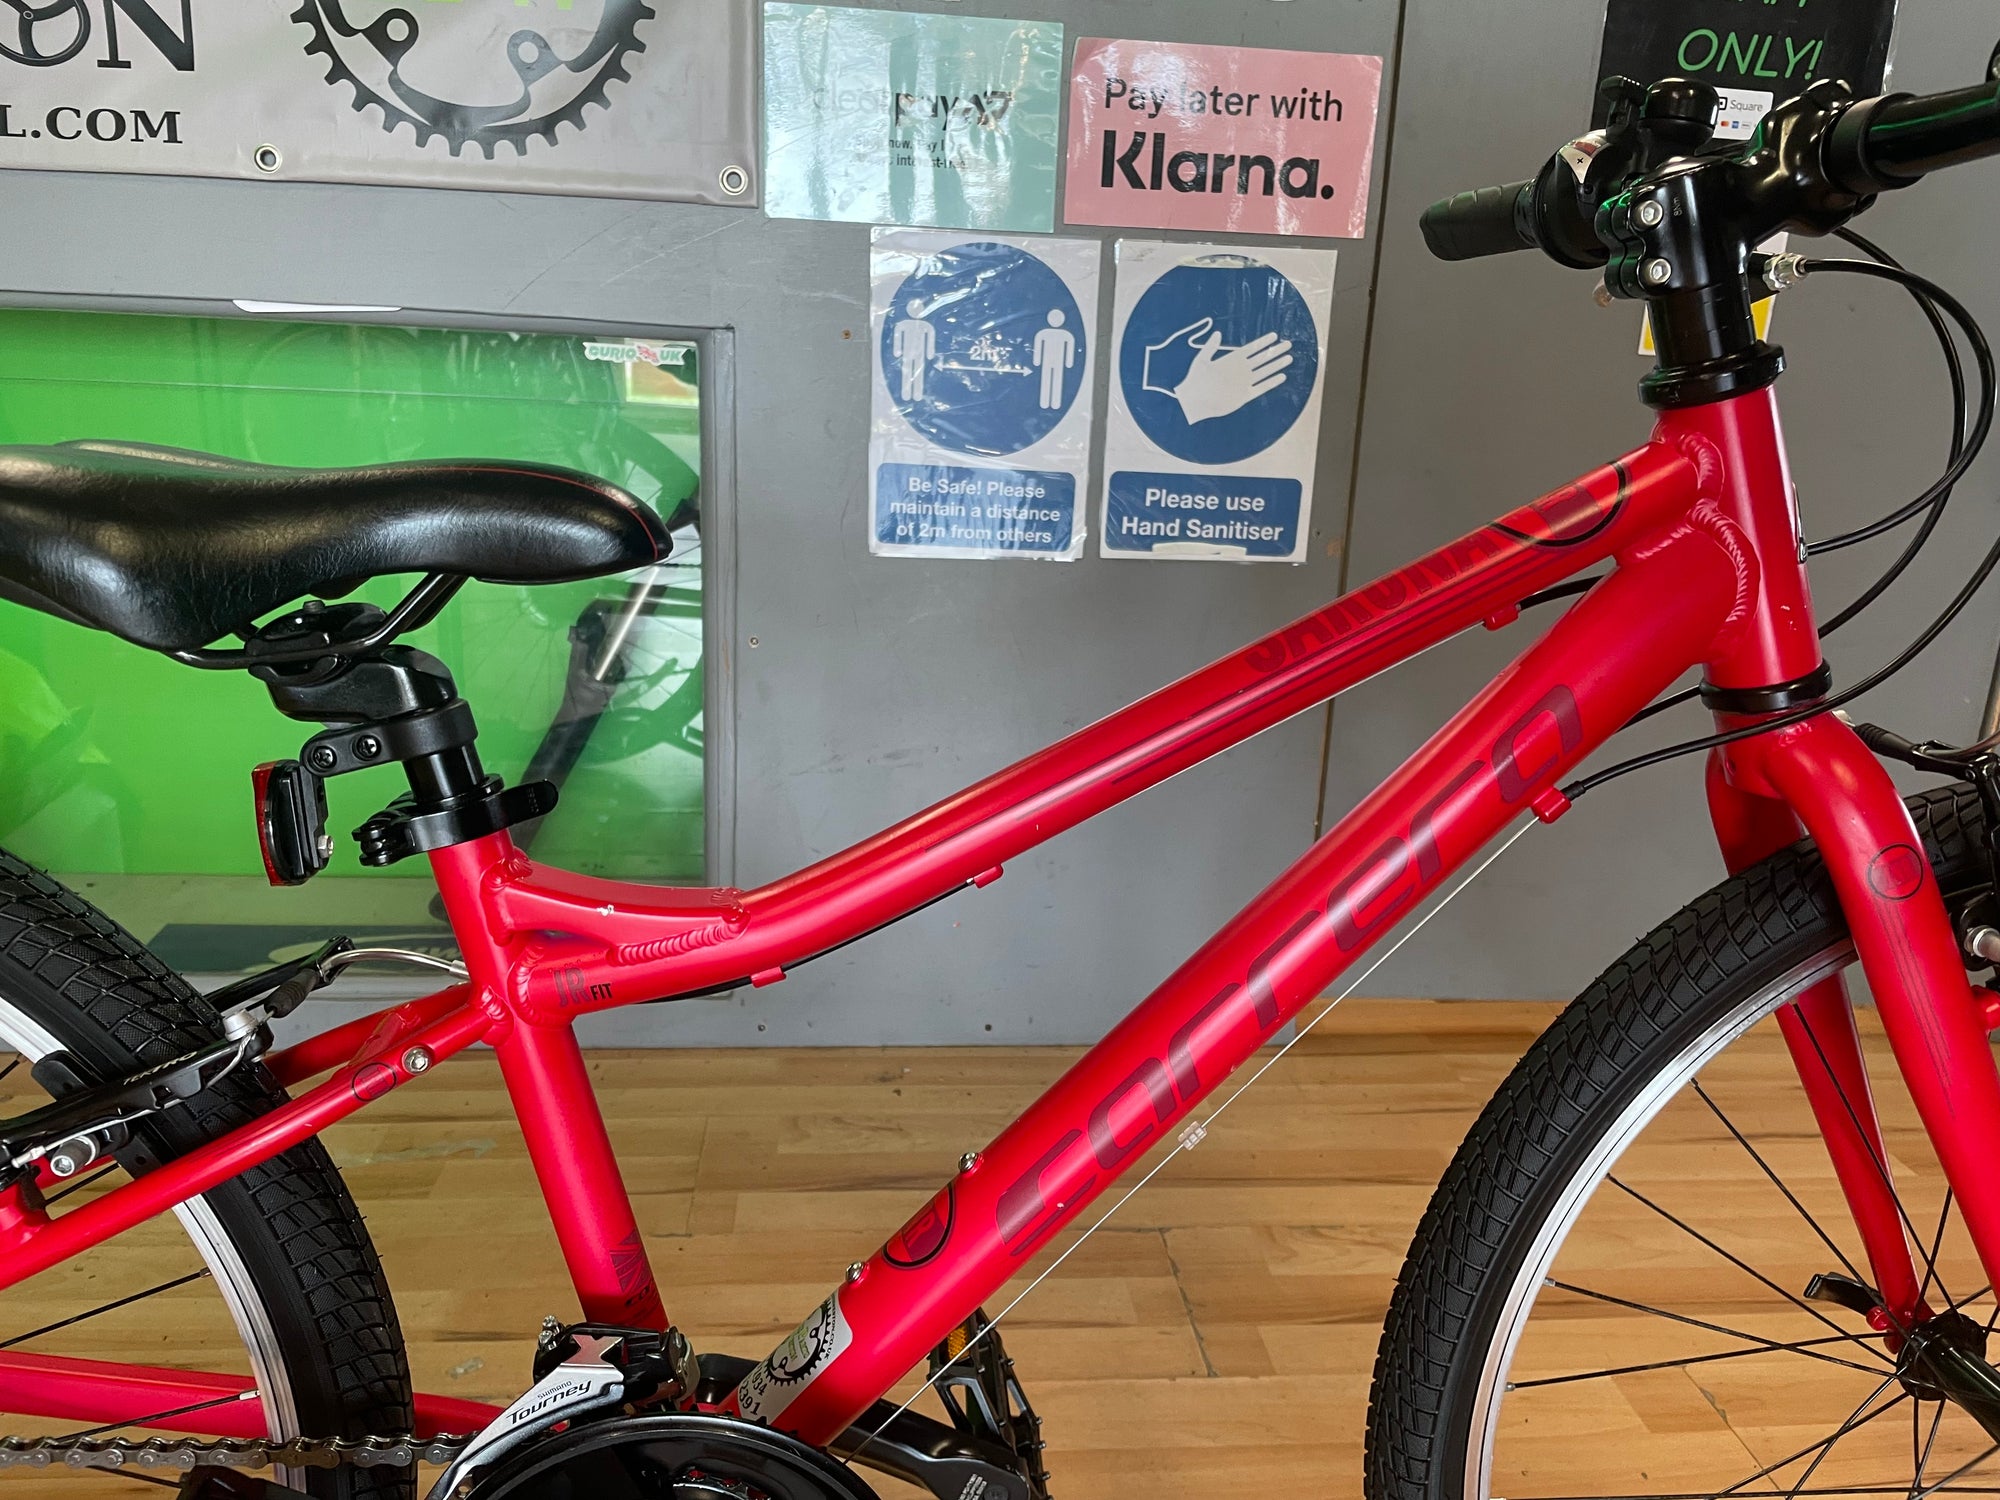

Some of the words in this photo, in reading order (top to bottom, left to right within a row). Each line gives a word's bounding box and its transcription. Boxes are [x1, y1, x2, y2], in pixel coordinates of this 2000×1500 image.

[1677, 28, 1824, 81] ONLY!
[1104, 76, 1168, 119] Pay
[1180, 81, 1261, 117] later
[1270, 87, 1343, 122] with
[1729, 99, 1764, 113] Square
[1100, 129, 1335, 200] Klarna.
[659, 350, 681, 361] UK
[908, 476, 932, 494] Be
[937, 478, 983, 497] Safe!
[986, 480, 1046, 499] Please
[890, 500, 966, 518] maintain
[970, 506, 982, 518] a
[986, 504, 1061, 522] distance
[1145, 488, 1220, 511] Please
[1226, 495, 1266, 513] use
[896, 522, 917, 538] of
[919, 523, 946, 539] 2m
[950, 524, 991, 541] from
[996, 526, 1053, 544] others
[1121, 516, 1181, 538] Hand
[1185, 518, 1285, 542] Sanitiser
[589, 982, 614, 1001] FIT
[537, 1380, 573, 1400] SHIMANO
[505, 1379, 592, 1425] Tourney
